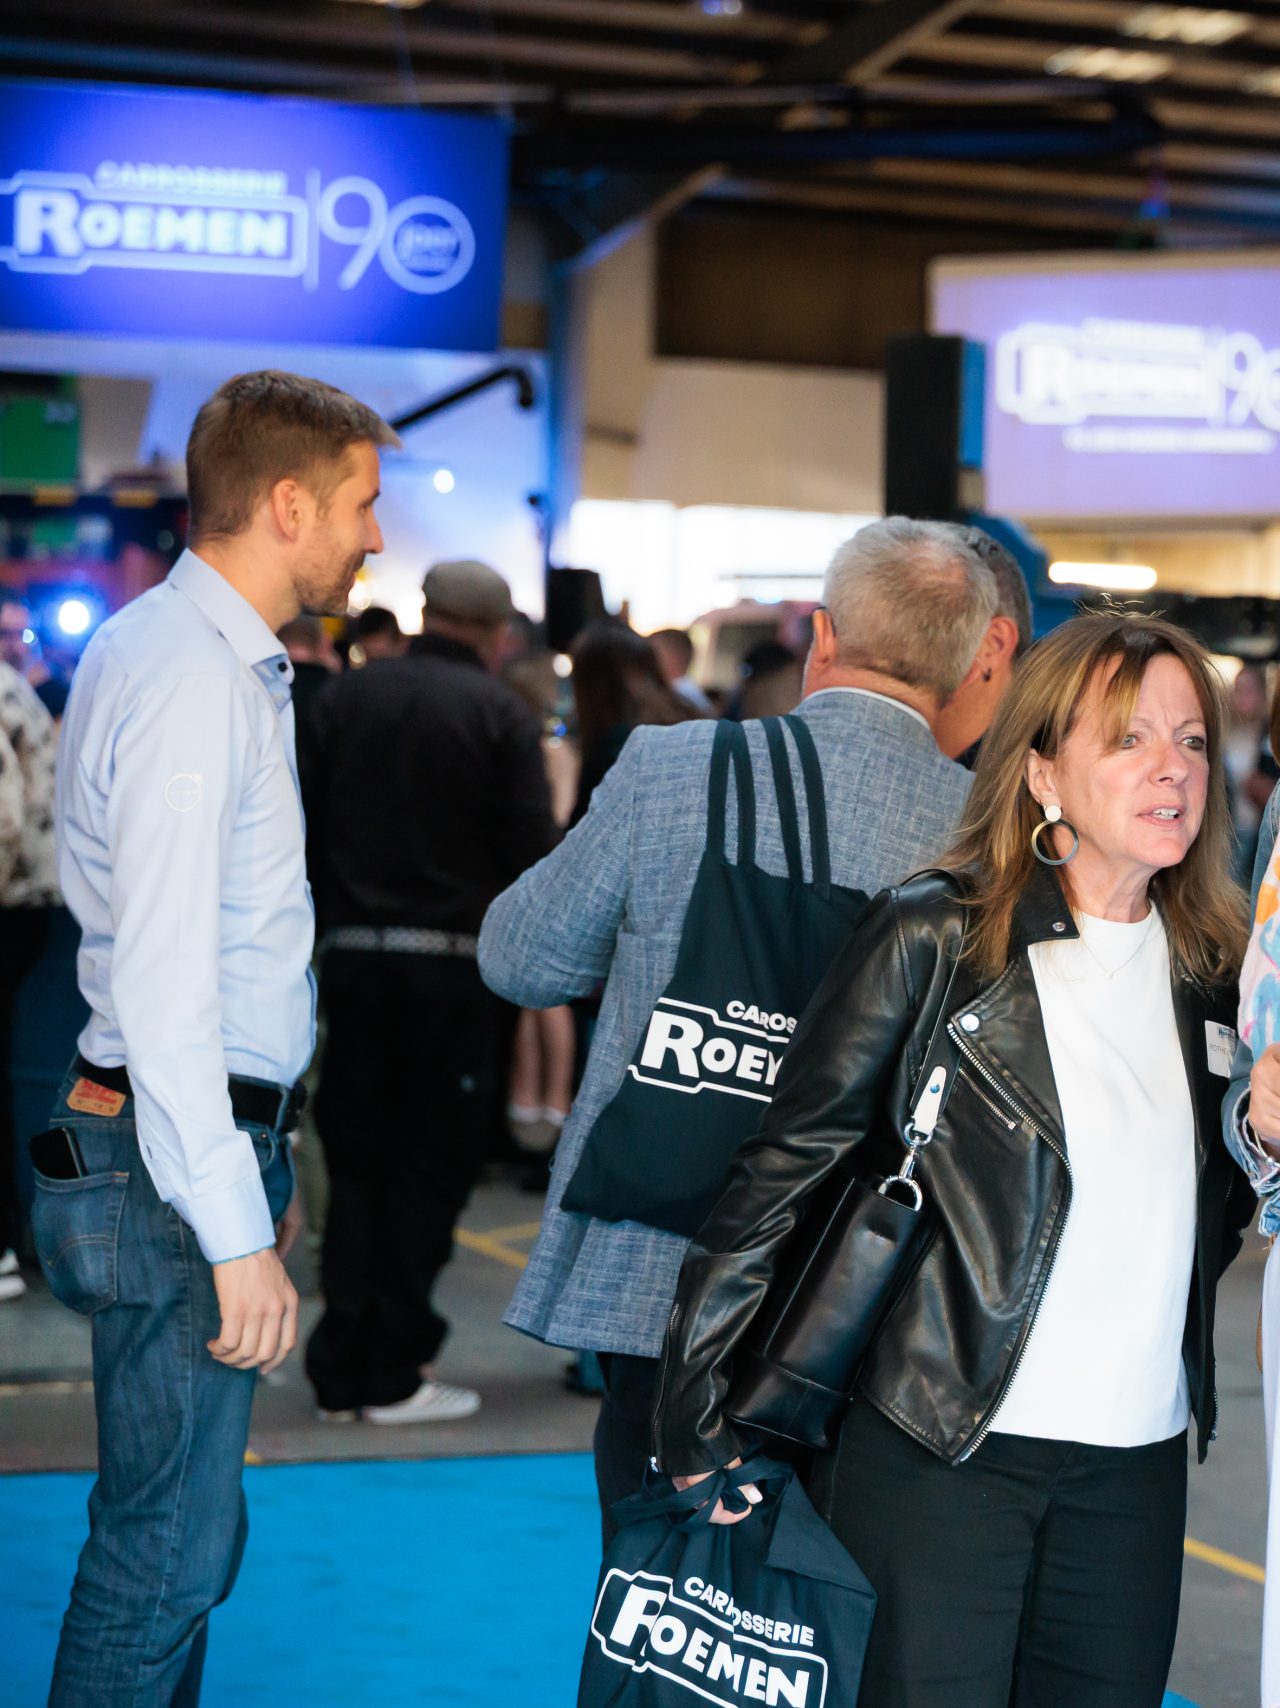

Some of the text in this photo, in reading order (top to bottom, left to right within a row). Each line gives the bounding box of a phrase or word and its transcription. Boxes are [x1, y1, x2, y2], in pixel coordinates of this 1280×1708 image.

[14, 188, 289, 258] ROEMEN
[316, 175, 476, 295] 90
[726, 1000, 798, 1034] CAROS
